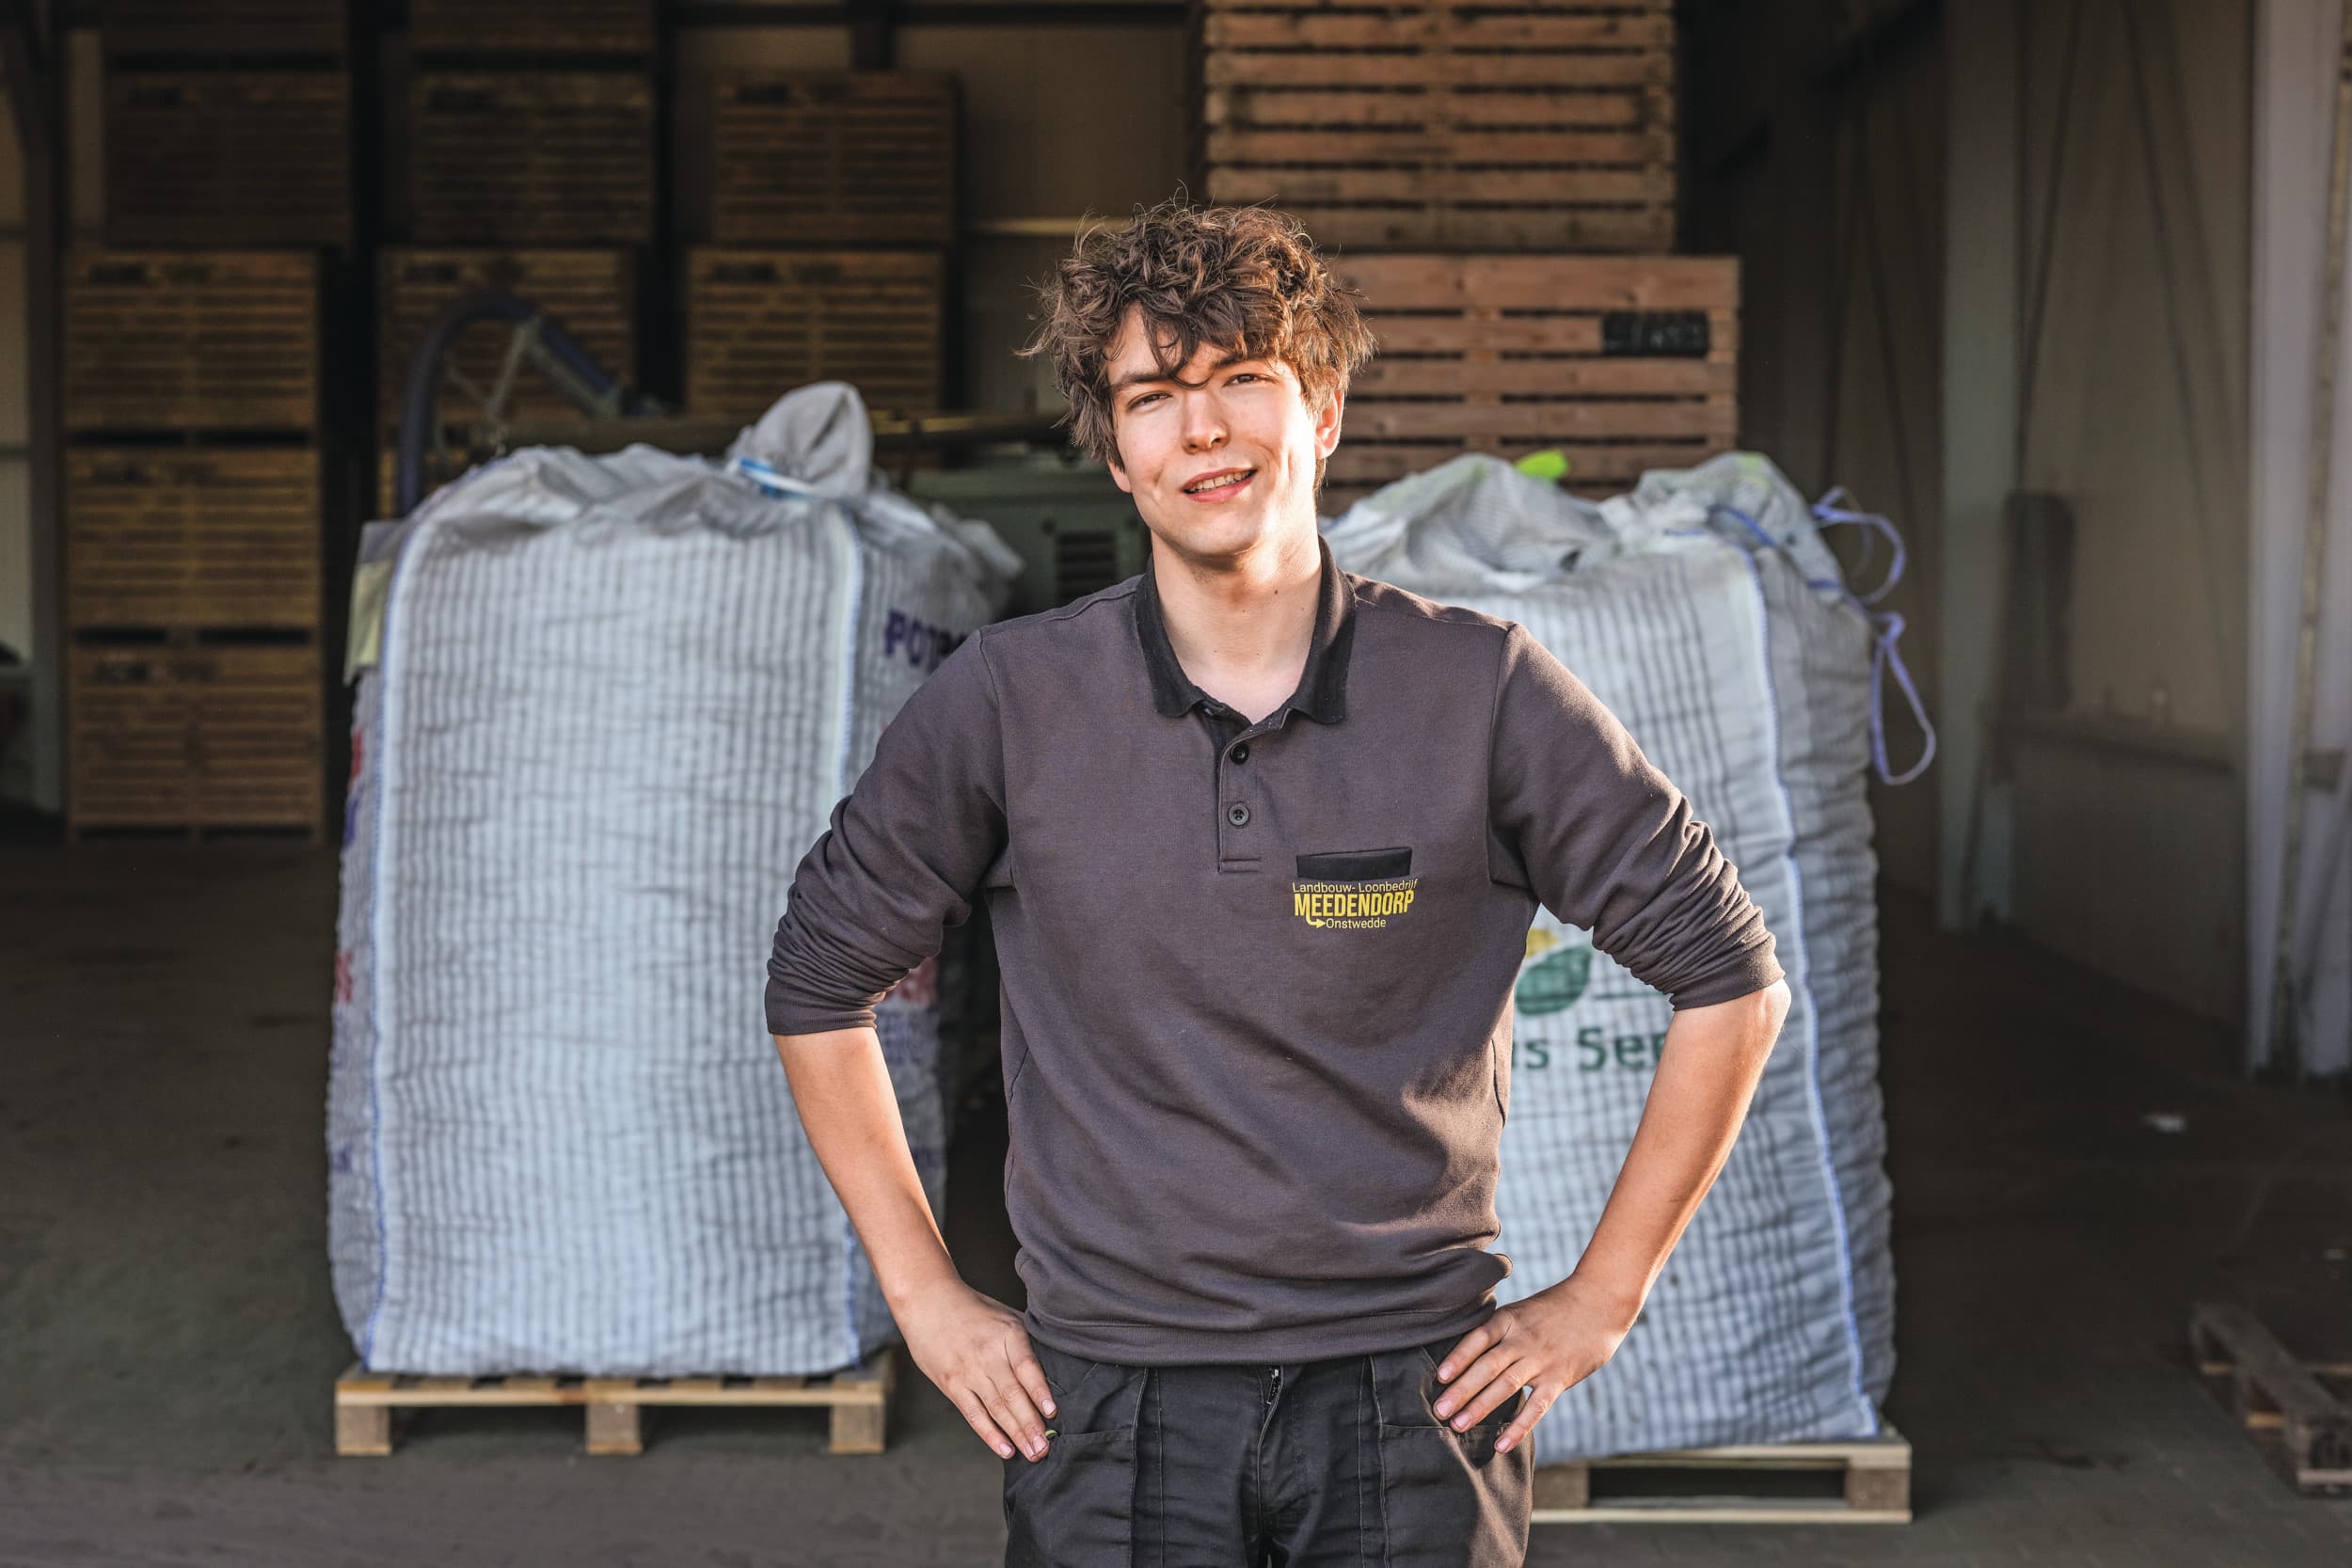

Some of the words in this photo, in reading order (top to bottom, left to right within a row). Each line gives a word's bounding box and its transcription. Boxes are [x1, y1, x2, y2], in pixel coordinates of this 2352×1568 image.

[1292, 882, 1356, 893] Landbouw-
[1359, 879, 1418, 892] Loonbedrijf
[1294, 890, 1415, 917] MEEDENDORP
[1326, 917, 1387, 929] Onstwedde
[1511, 1037, 1549, 1069] s
